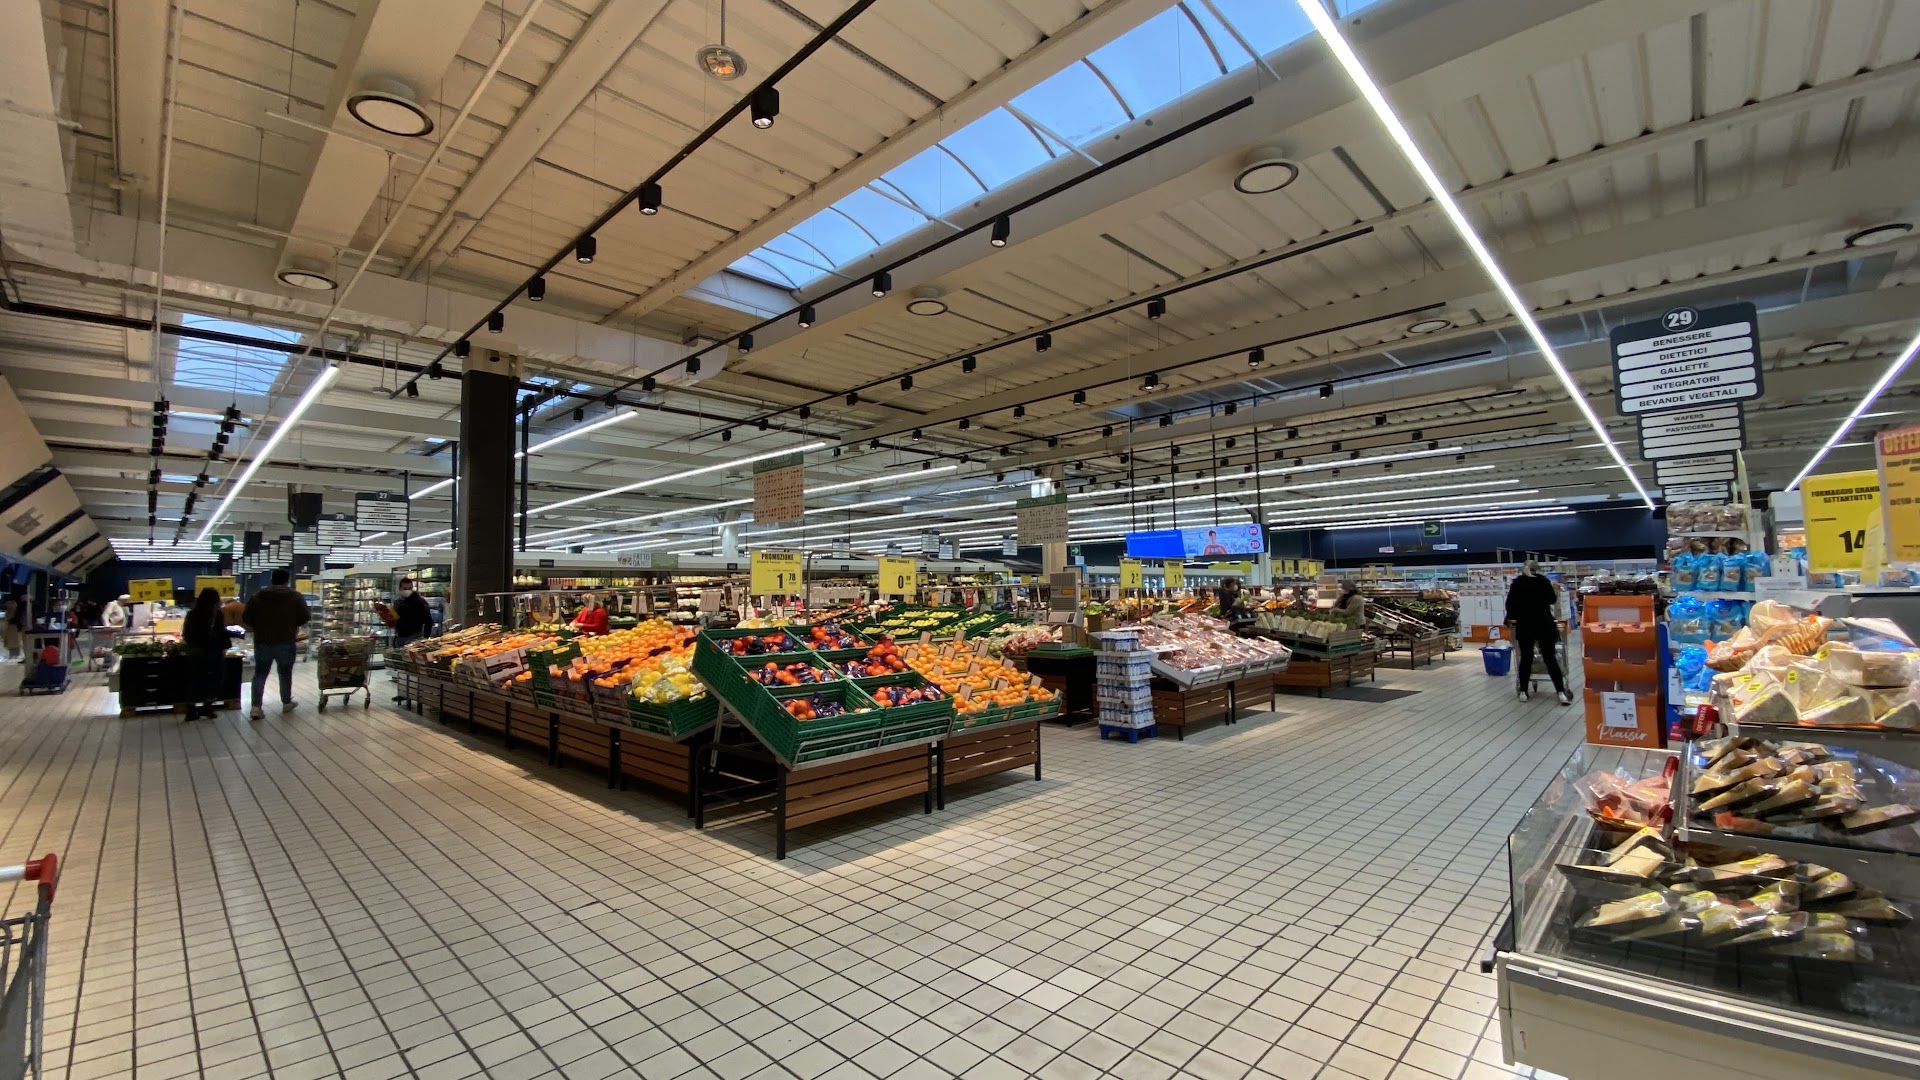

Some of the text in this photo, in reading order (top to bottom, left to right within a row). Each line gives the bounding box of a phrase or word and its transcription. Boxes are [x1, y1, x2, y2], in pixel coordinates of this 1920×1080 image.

[1667, 310, 1692, 328] 29
[1652, 331, 1712, 347] BENESSERE
[1659, 347, 1708, 360] DIETETICI
[1660, 361, 1710, 375] GALLETTE
[1652, 376, 1720, 391] INTEGRATORI
[1639, 388, 1738, 408] BEVANDE VEGETALI
[1666, 423, 1715, 432] PASTICCERIA
[1811, 488, 1854, 497] FORMAGGIO
[1824, 494, 1873, 503] SETTANTOTTO
[1696, 706, 1707, 732] OFFERTA
[1597, 722, 1648, 741] Plaisir
